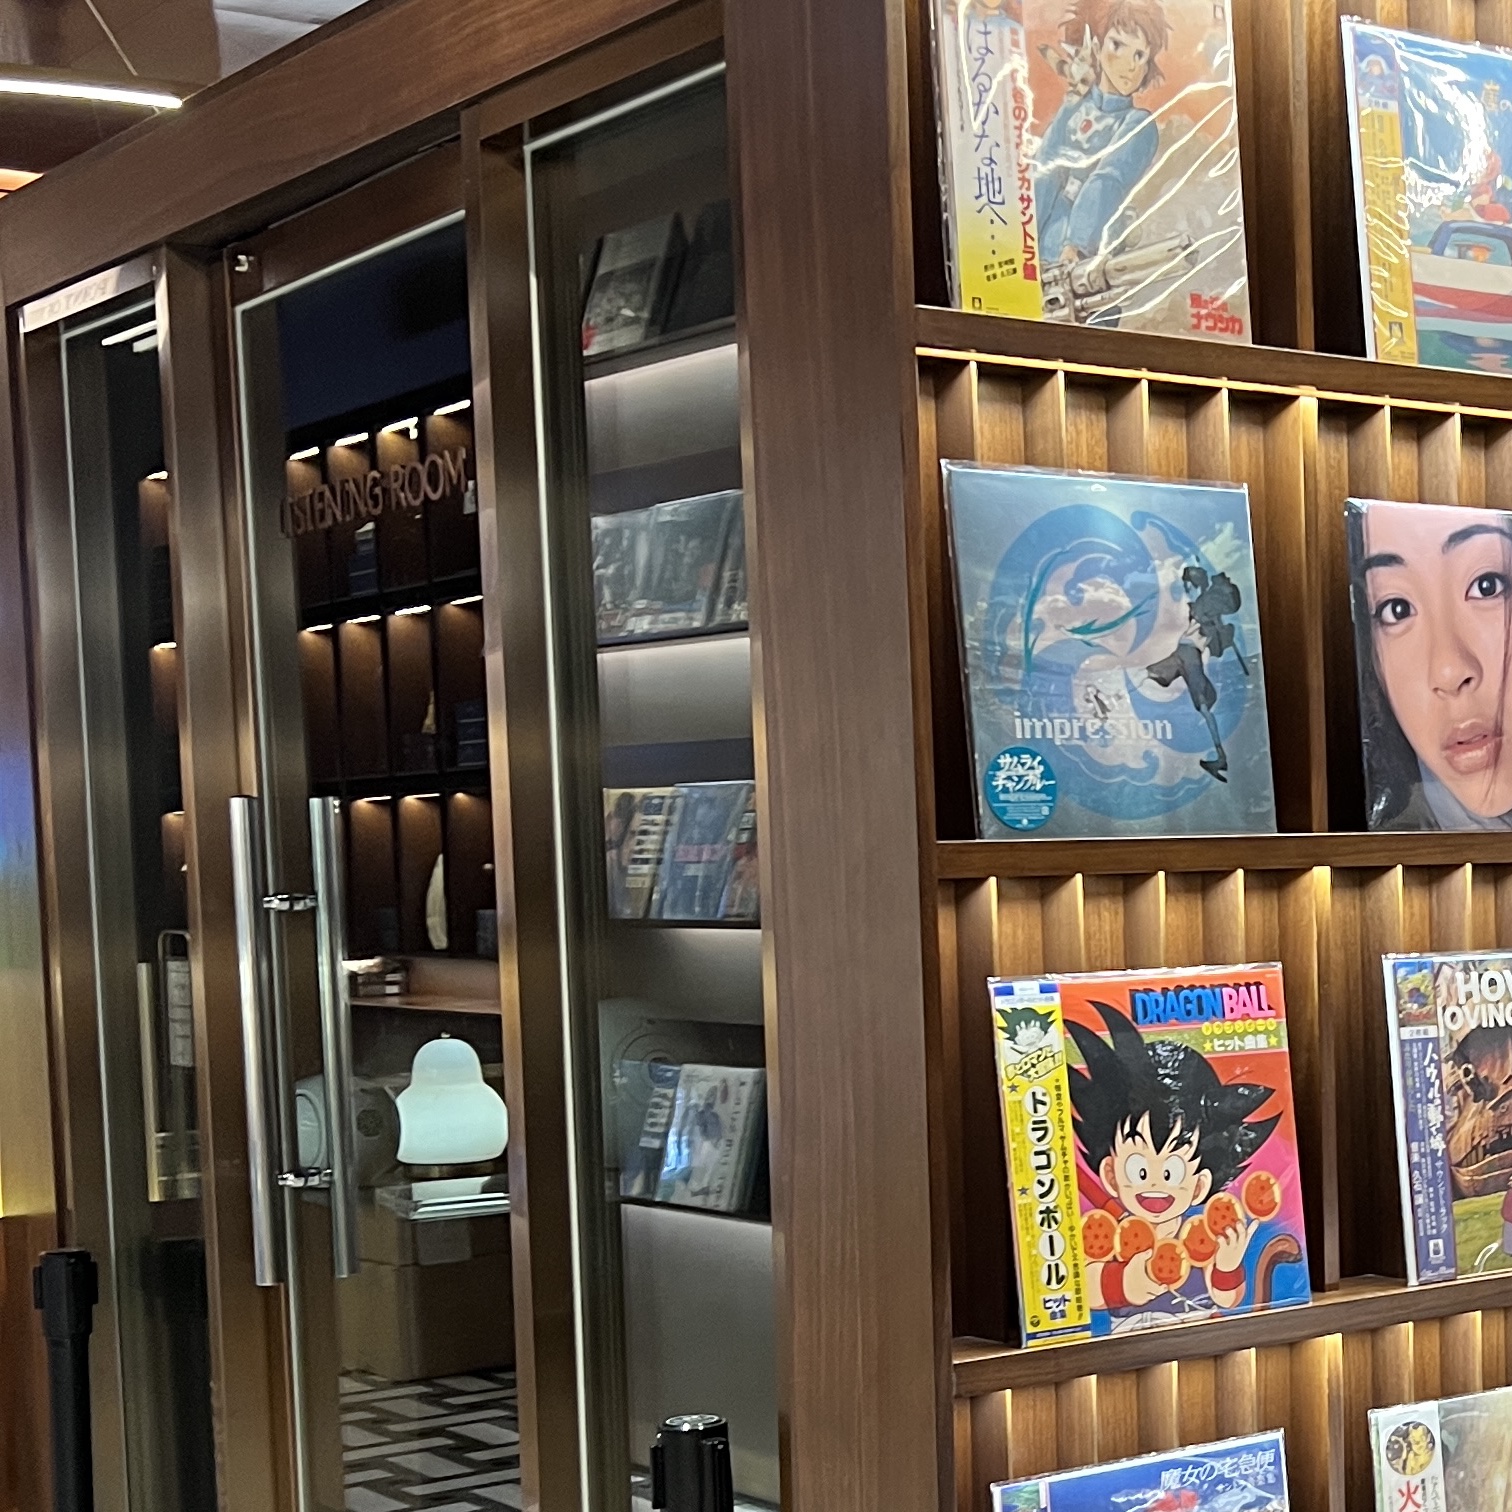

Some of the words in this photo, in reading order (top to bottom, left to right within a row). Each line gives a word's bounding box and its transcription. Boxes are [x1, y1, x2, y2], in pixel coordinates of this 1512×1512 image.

[390, 447, 467, 510] ROOM
[1013, 711, 1173, 746] impression
[1133, 988, 1224, 1025] DRAGON
[1222, 984, 1277, 1020] BALL
[1027, 1090, 1068, 1288] ドラゴンボール
[1160, 1448, 1276, 1491] 魔女の宅急便
